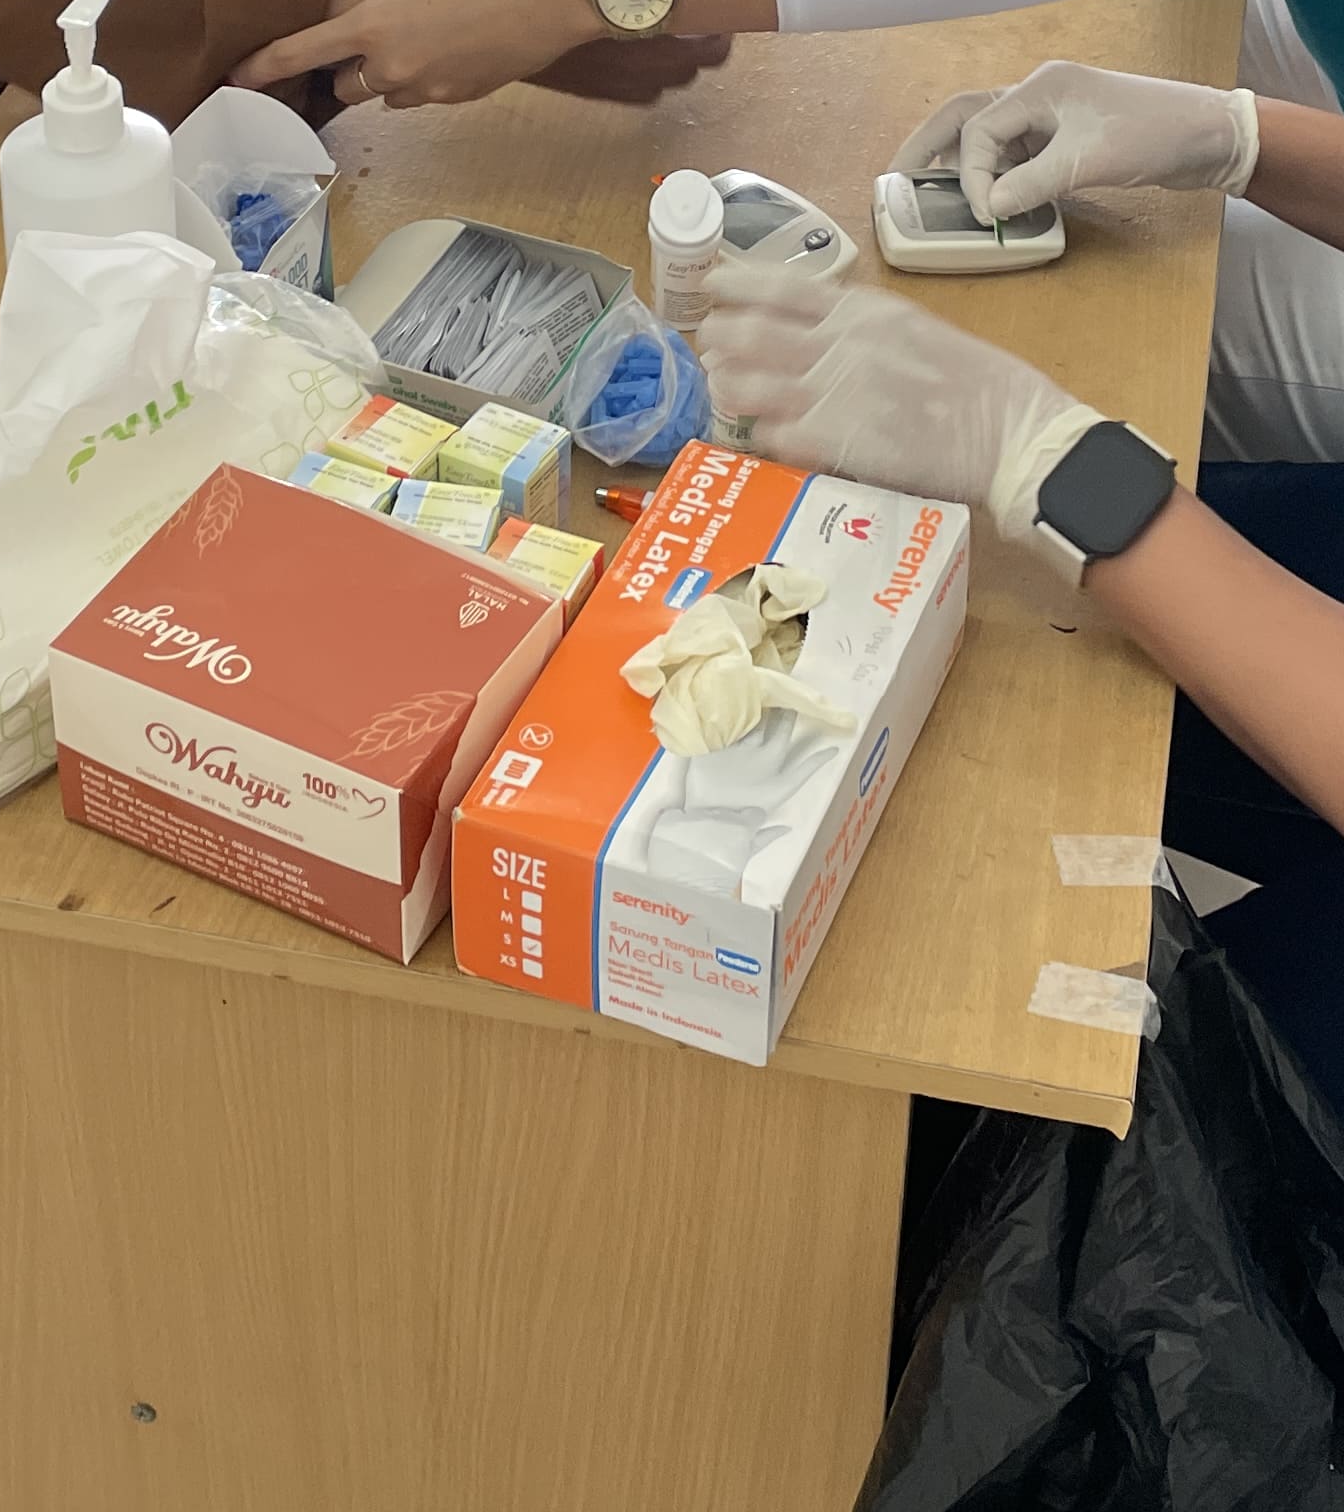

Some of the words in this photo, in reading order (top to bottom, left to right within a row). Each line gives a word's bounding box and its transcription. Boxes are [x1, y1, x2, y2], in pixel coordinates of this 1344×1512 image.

[669, 450, 737, 526] Medis
[718, 457, 760, 508] Sarung
[689, 513, 732, 564] Tangan
[872, 506, 943, 614] serenity
[619, 530, 690, 602] Latex
[467, 588, 508, 611] HALAL
[112, 605, 252, 684] Wahyu
[145, 722, 291, 809] Wahyu
[302, 773, 350, 800] 100%
[492, 847, 548, 890] SIZE
[502, 887, 511, 901] L
[612, 890, 690, 926] serenity
[500, 909, 514, 924] M
[499, 953, 518, 968] XS
[503, 933, 512, 946] S
[609, 920, 659, 946] Sarung
[663, 937, 714, 961] Tangan
[608, 934, 685, 975] Medis
[692, 961, 761, 999] Latex
[608, 994, 643, 1012] Made
[647, 1006, 658, 1018] in
[661, 1011, 723, 1039] Indonesia
